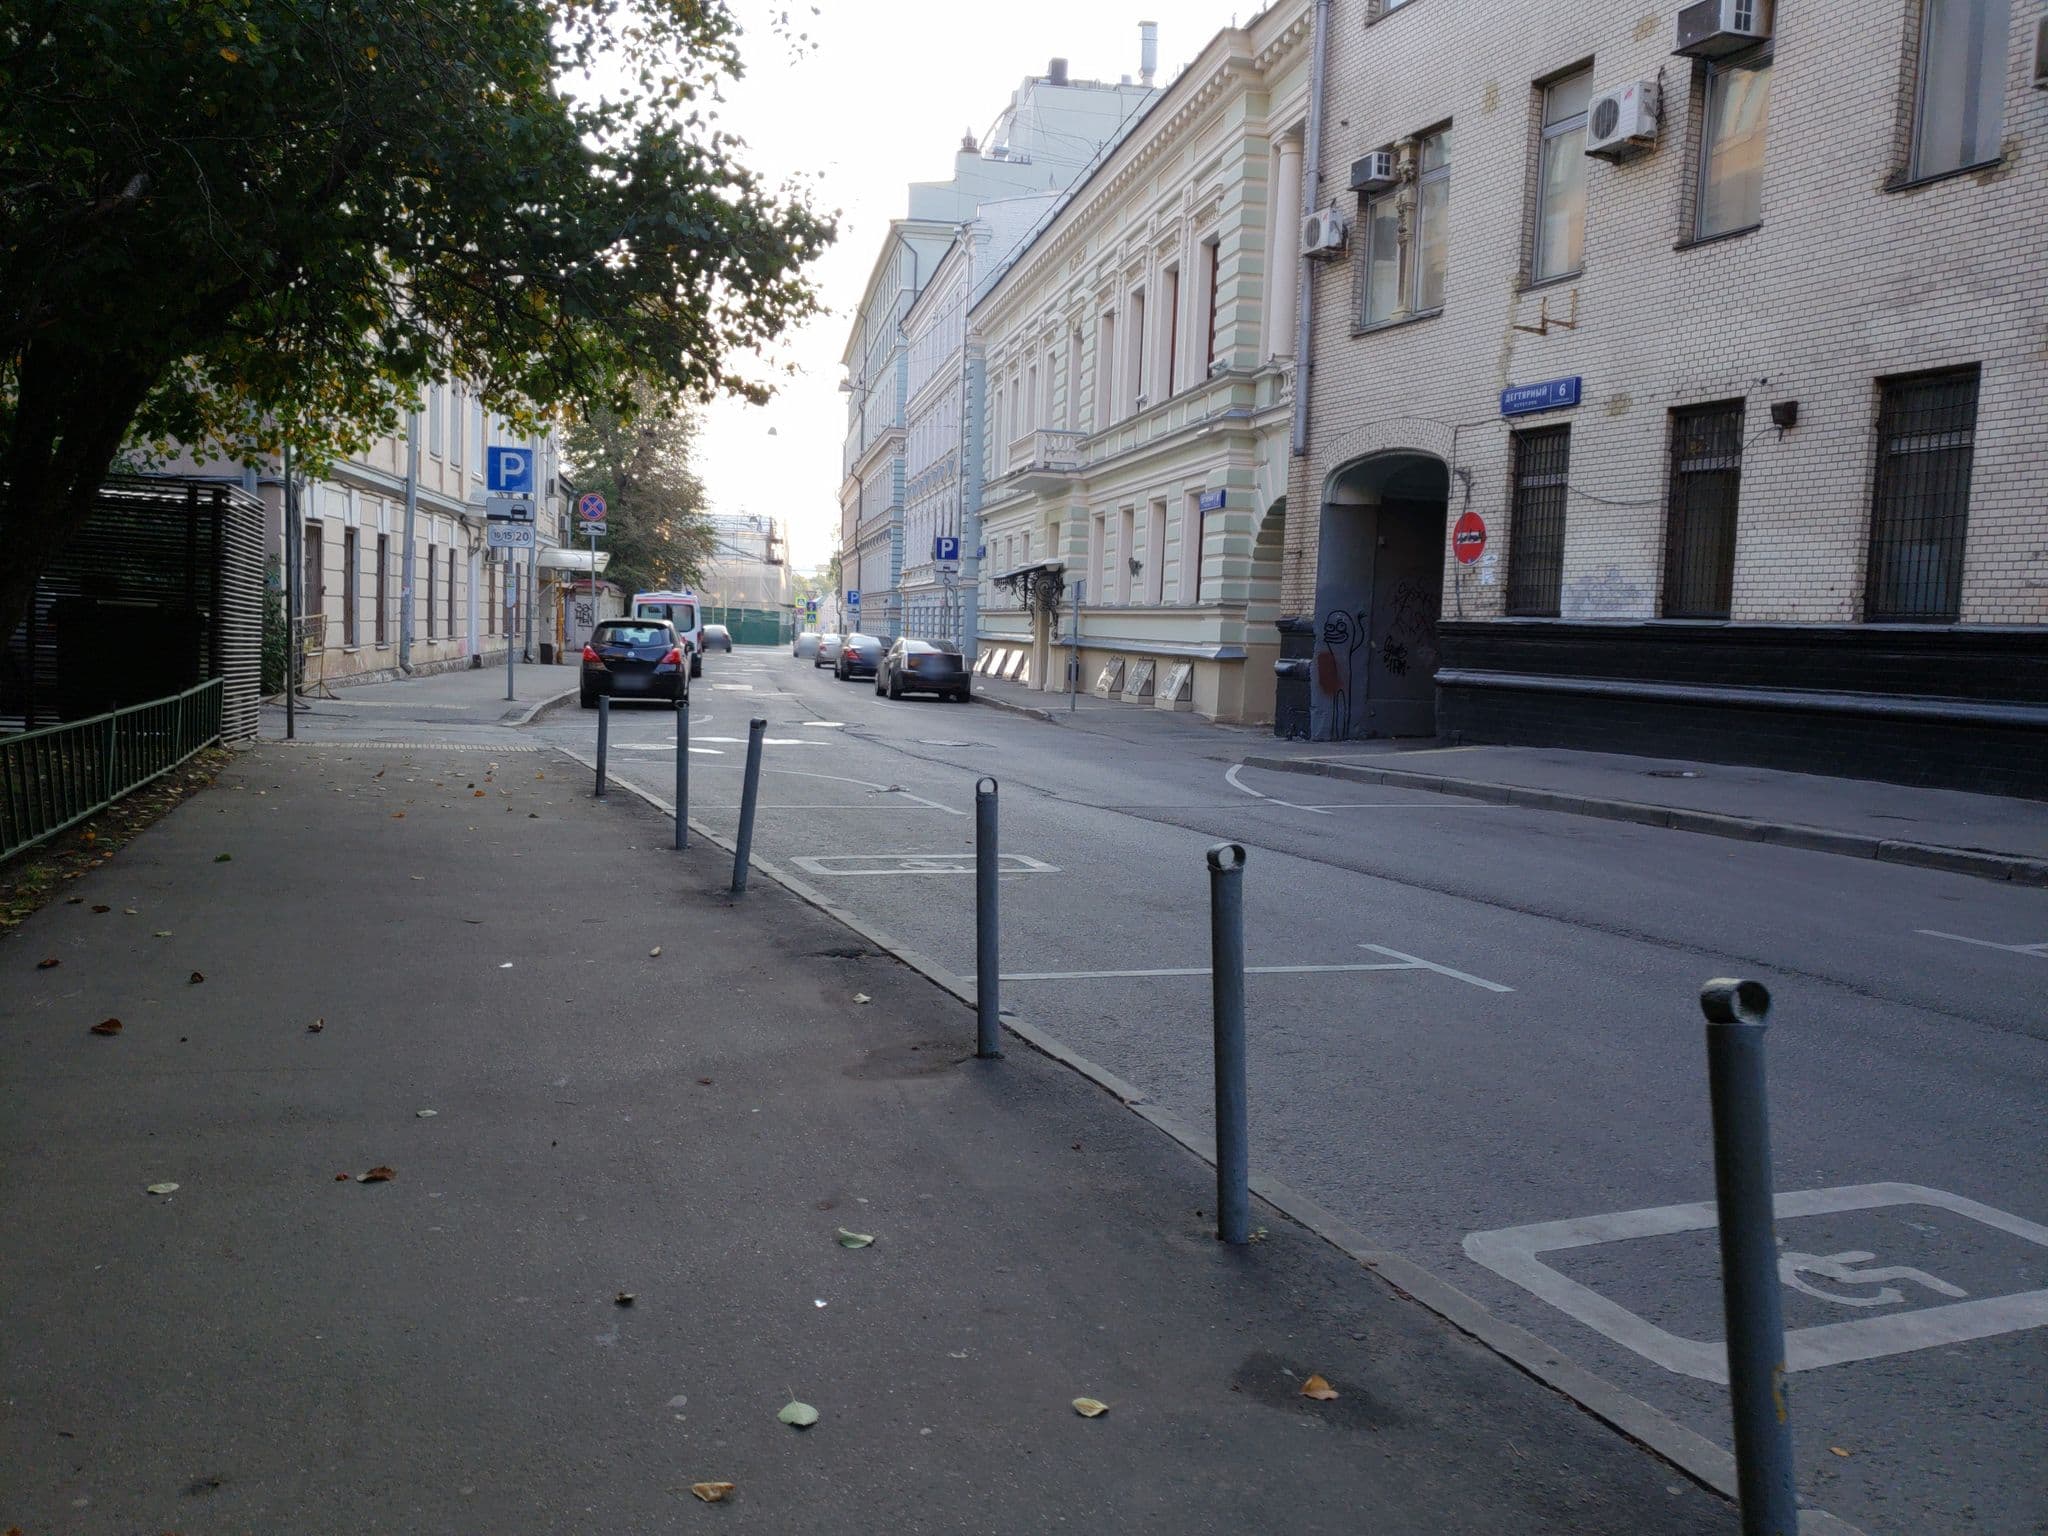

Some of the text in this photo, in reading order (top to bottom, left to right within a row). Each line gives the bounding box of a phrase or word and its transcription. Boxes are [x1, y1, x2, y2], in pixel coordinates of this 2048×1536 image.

[1558, 383, 1567, 396] 6
[500, 452, 525, 487] P
[503, 532, 512, 540] 15
[515, 532, 529, 541] 20
[941, 539, 954, 558] P
[850, 592, 859, 603] P
